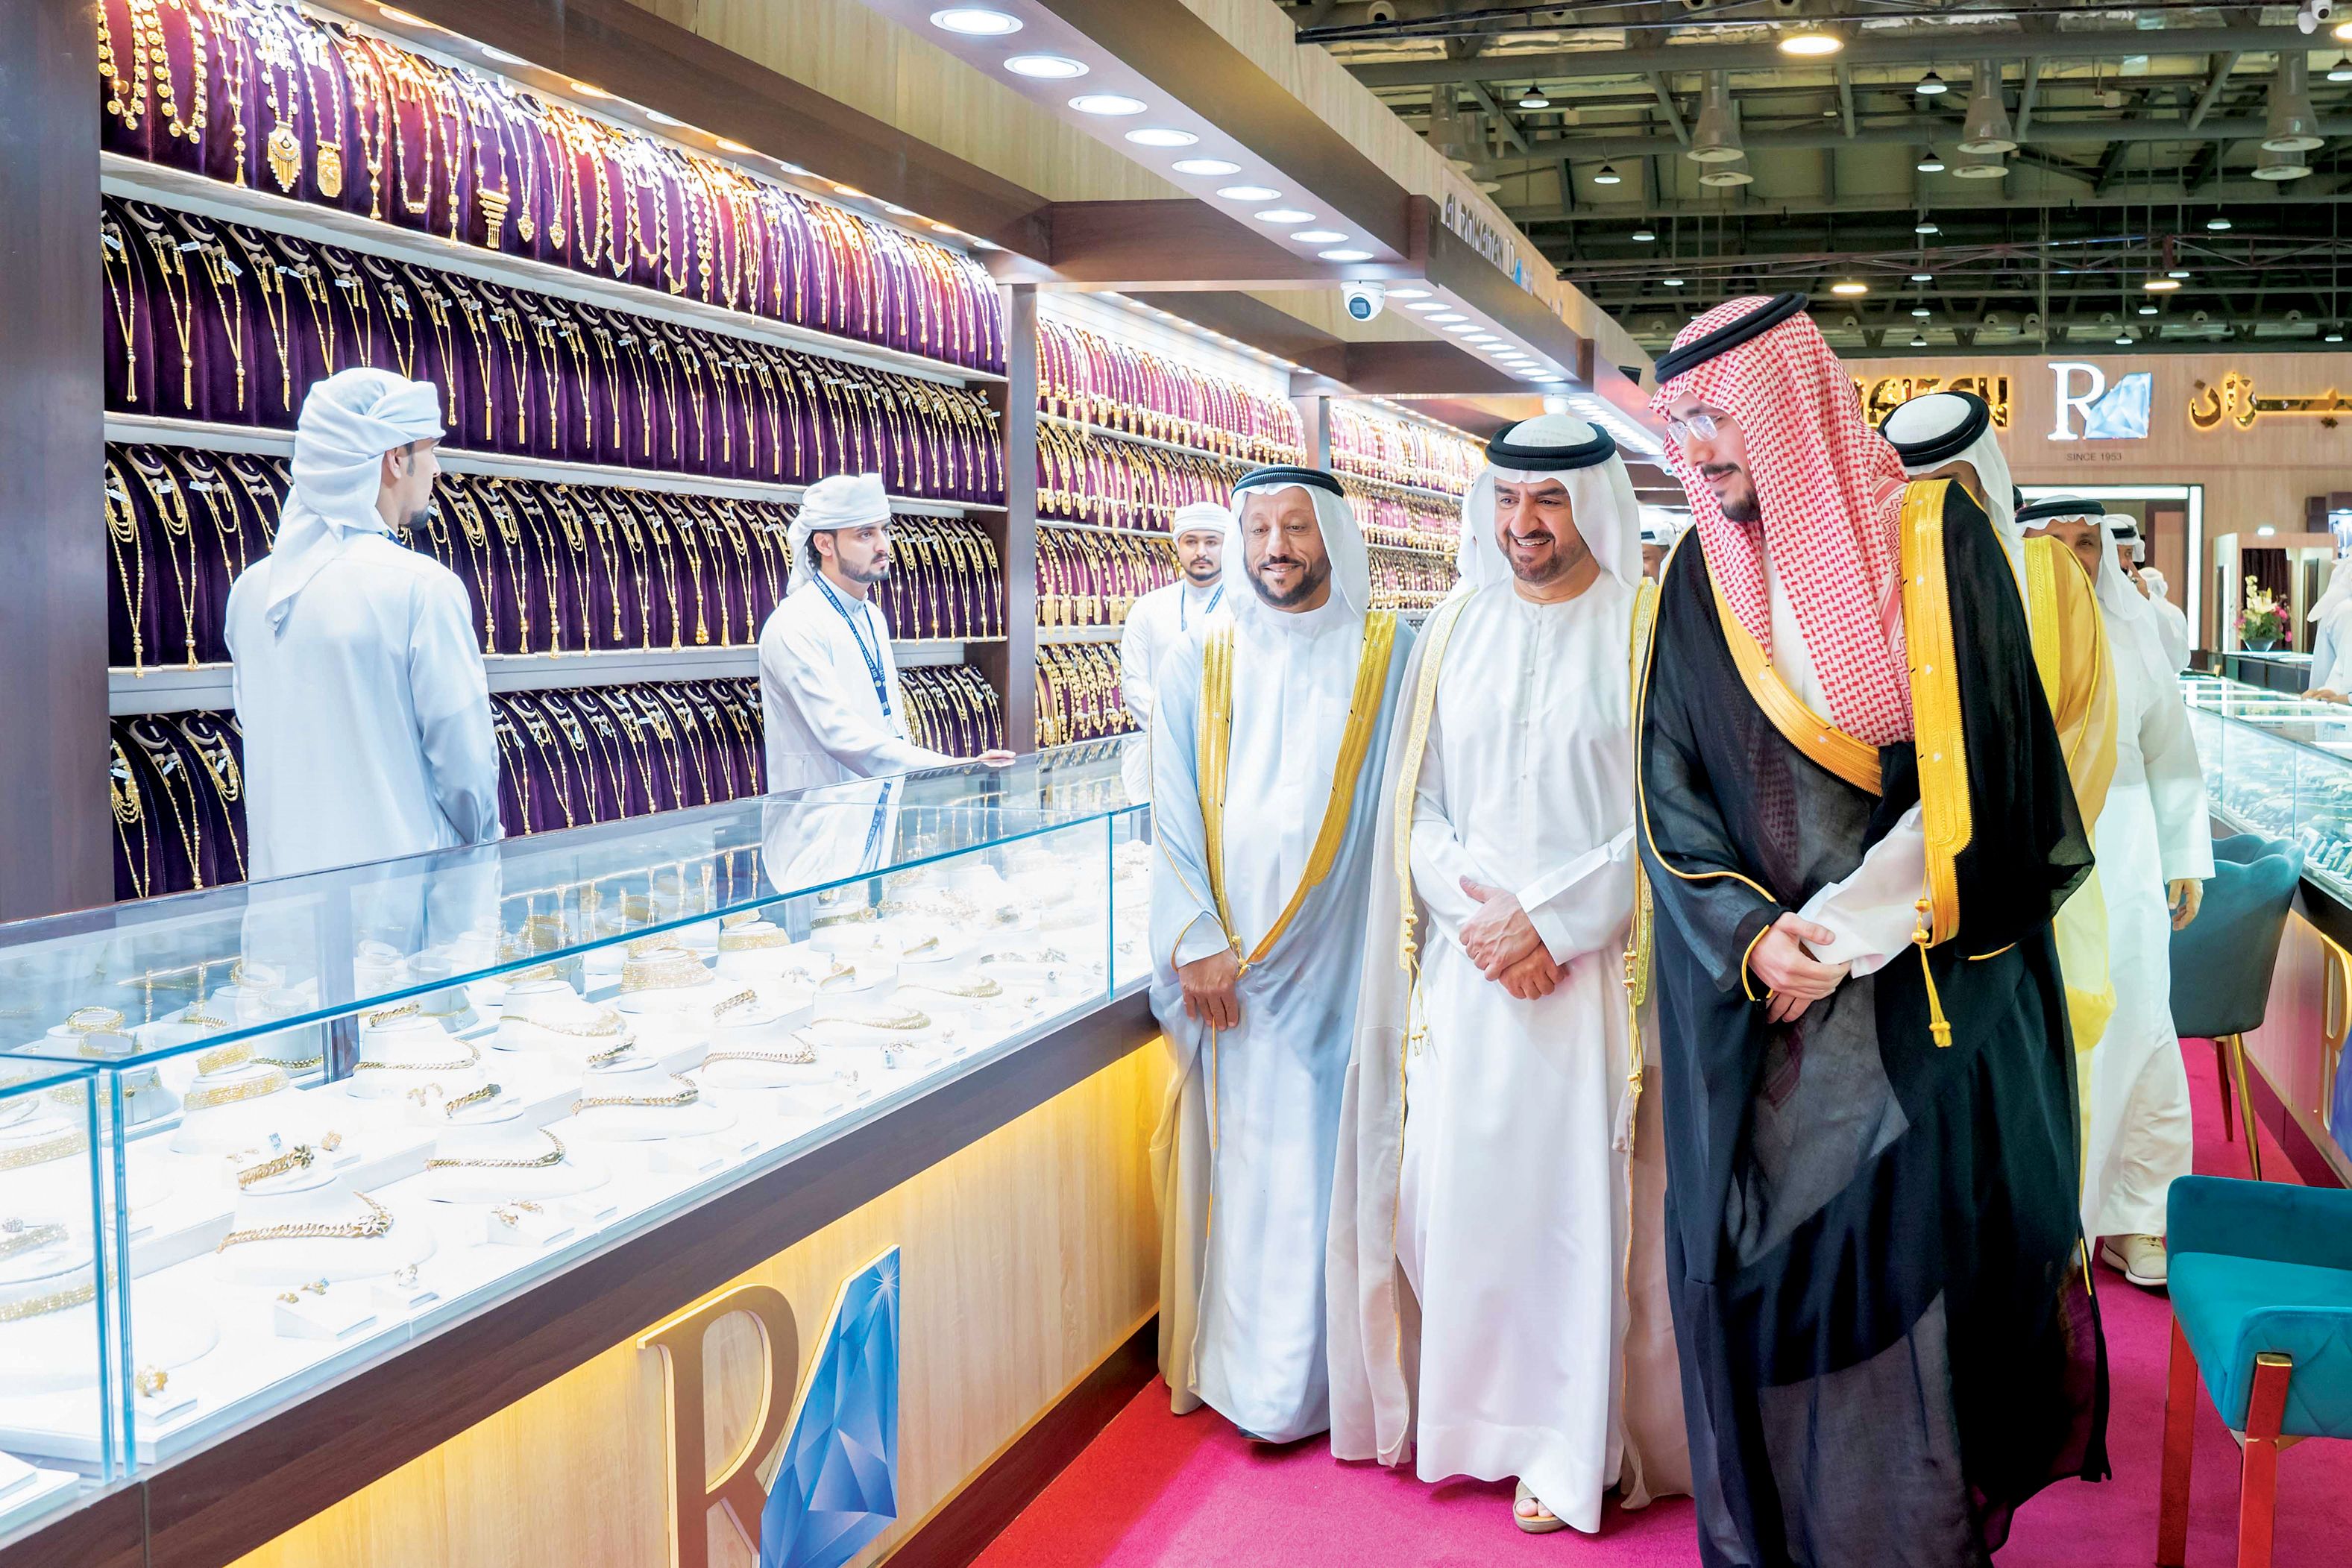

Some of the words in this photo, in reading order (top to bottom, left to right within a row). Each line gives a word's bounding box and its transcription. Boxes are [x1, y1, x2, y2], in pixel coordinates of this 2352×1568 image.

[2047, 362, 2105, 441] R
[2066, 453, 2096, 462] SINCE
[2101, 453, 2122, 461] 1953
[636, 1283, 799, 1568] R
